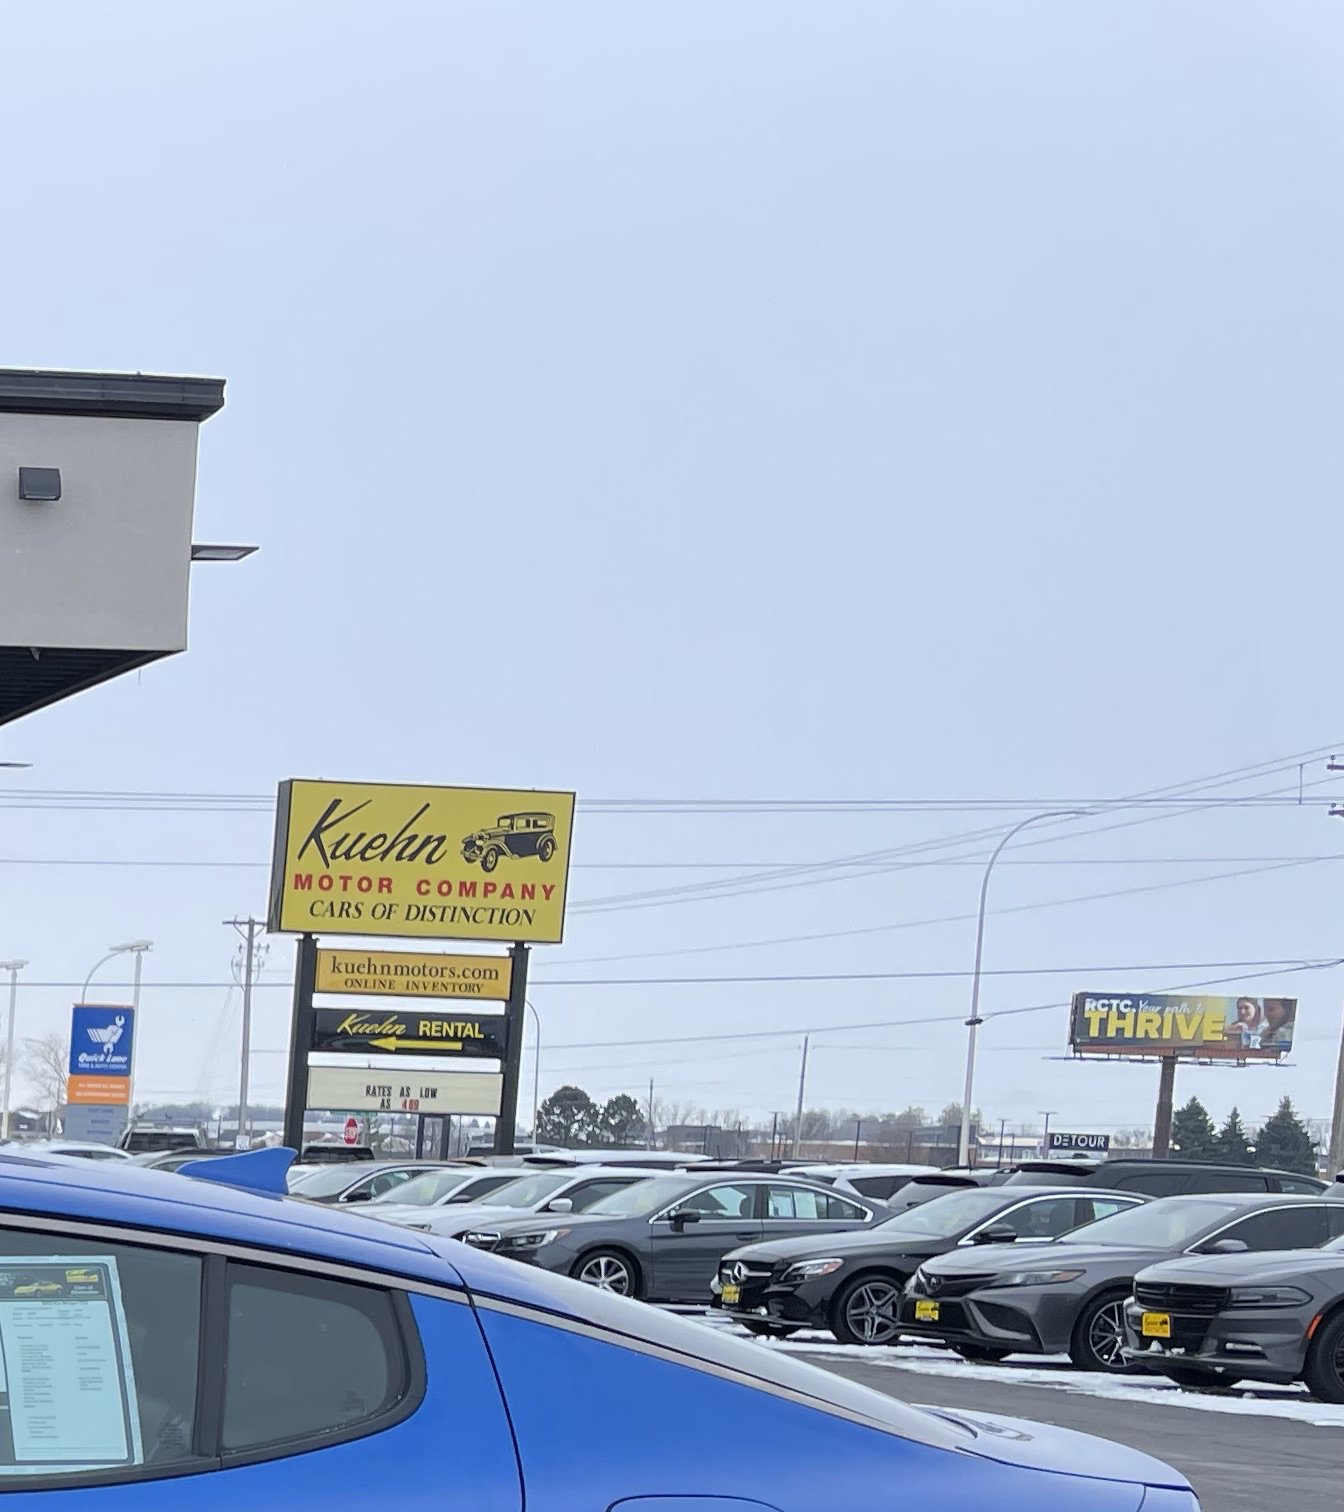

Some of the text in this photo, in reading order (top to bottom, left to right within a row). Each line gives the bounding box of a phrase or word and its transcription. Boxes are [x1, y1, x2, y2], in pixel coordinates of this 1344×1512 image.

[297, 798, 448, 869] Kuehn
[293, 873, 557, 901] MOTOR COMPANY
[309, 899, 537, 926] CARS OF DISTINCTION
[330, 955, 500, 981] kuehnmotors.com
[344, 977, 485, 995] ONLINE INVENTORY
[1084, 997, 1137, 1013] RCTC.
[336, 1012, 485, 1040] Kuehn RENTAL
[365, 1085, 438, 1099] RATES AS LOW
[379, 1098, 391, 1110] AS
[1053, 1133, 1106, 1148] DETOUR
